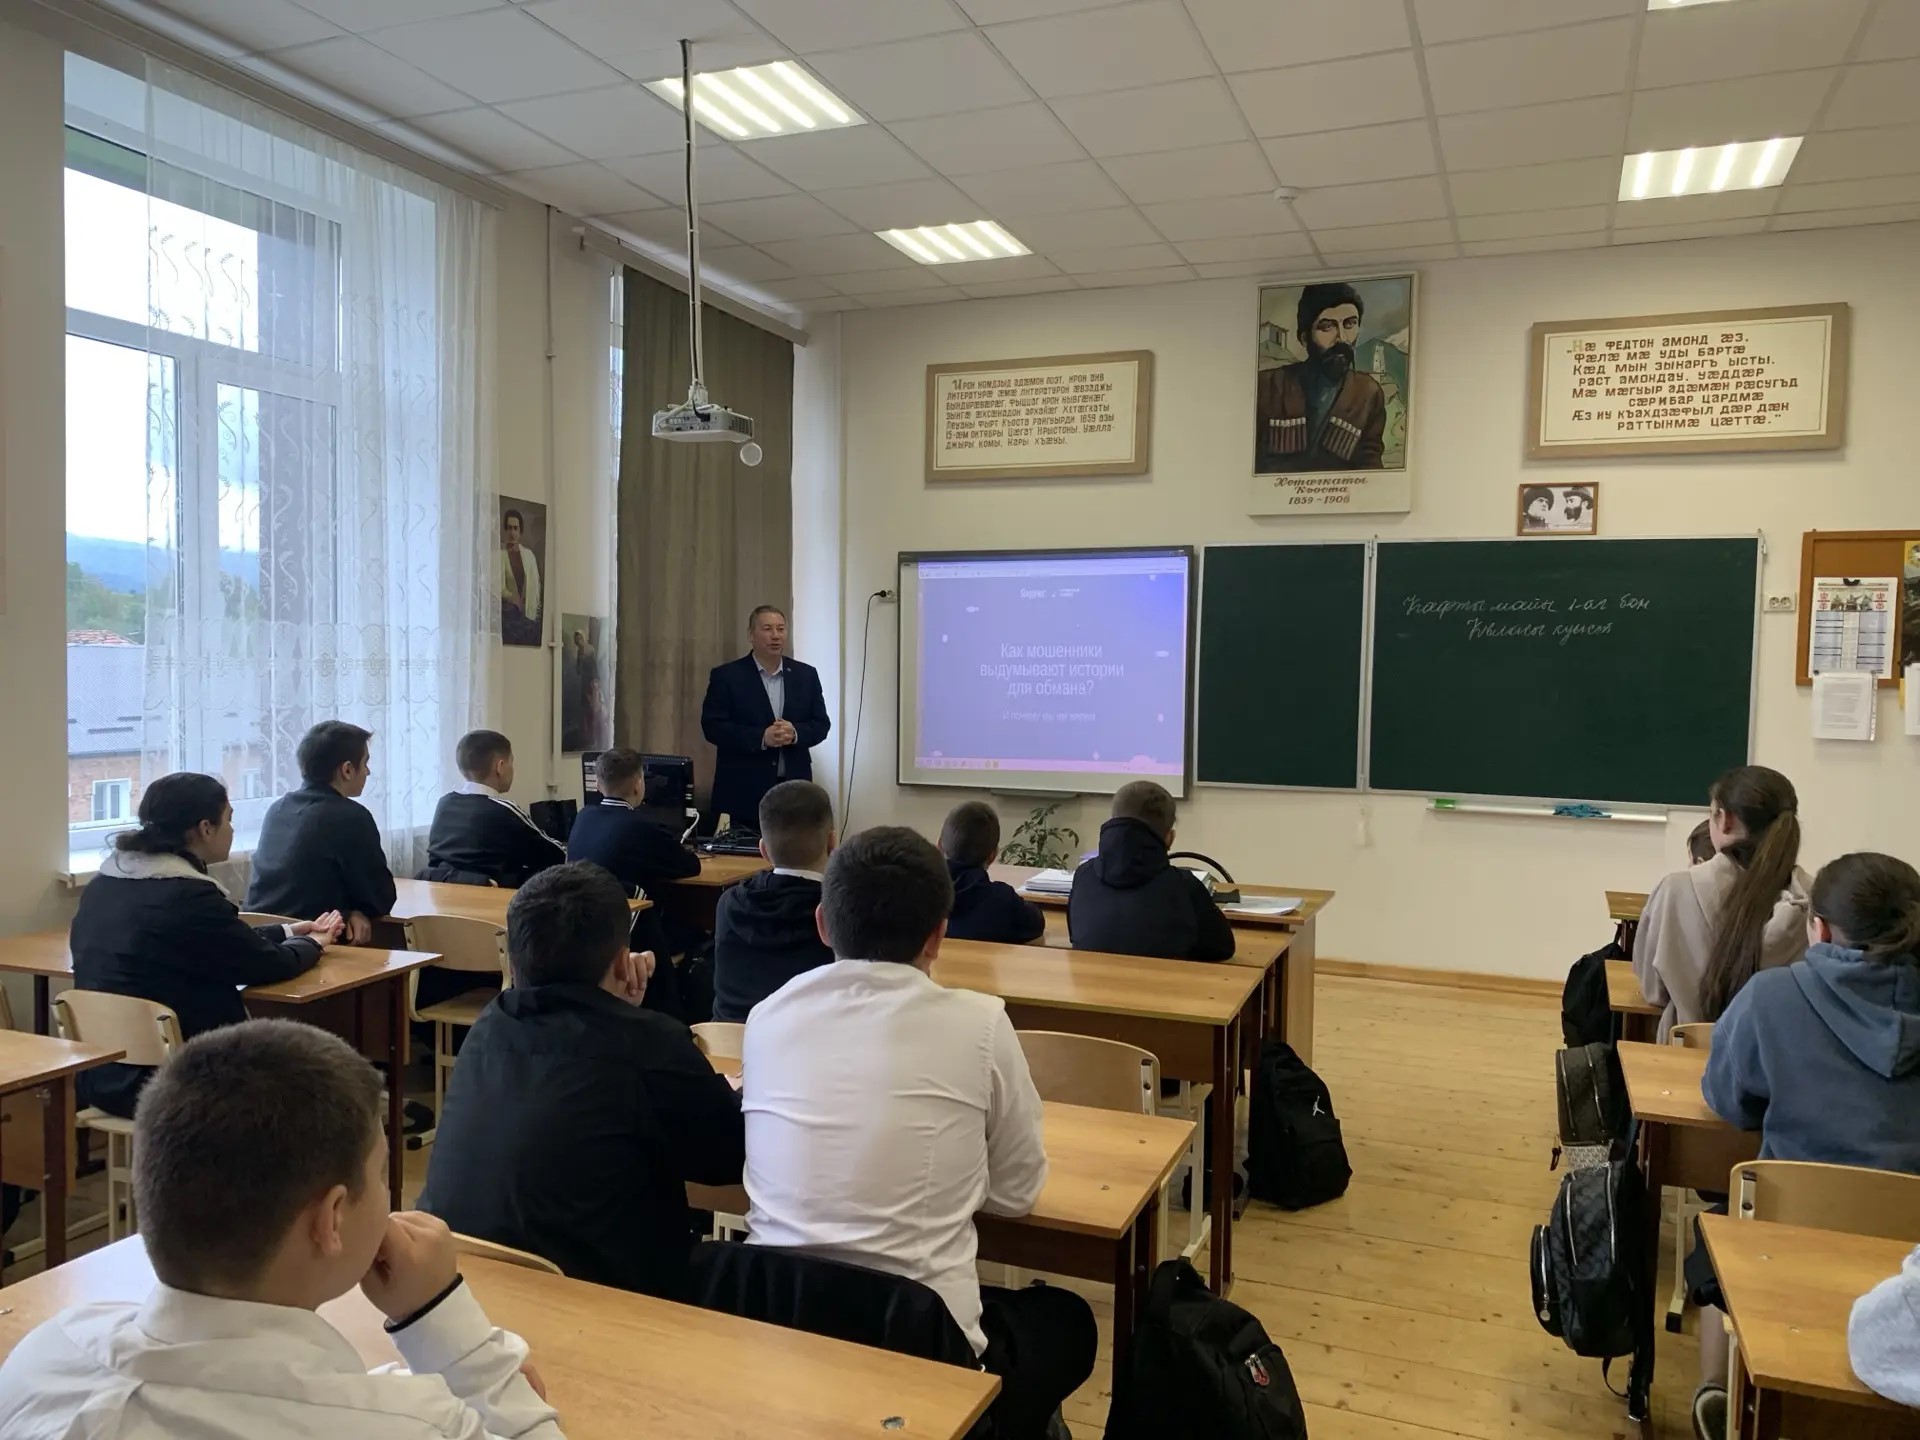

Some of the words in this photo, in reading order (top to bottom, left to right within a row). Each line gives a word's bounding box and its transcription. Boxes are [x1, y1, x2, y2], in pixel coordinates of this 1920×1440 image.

[1000, 642, 1023, 658] Как
[1027, 645, 1102, 658] мошенники
[980, 664, 1065, 680] выдумывают
[1069, 664, 1124, 679] истории
[1008, 682, 1032, 698] для
[1036, 679, 1094, 696] обмана?
